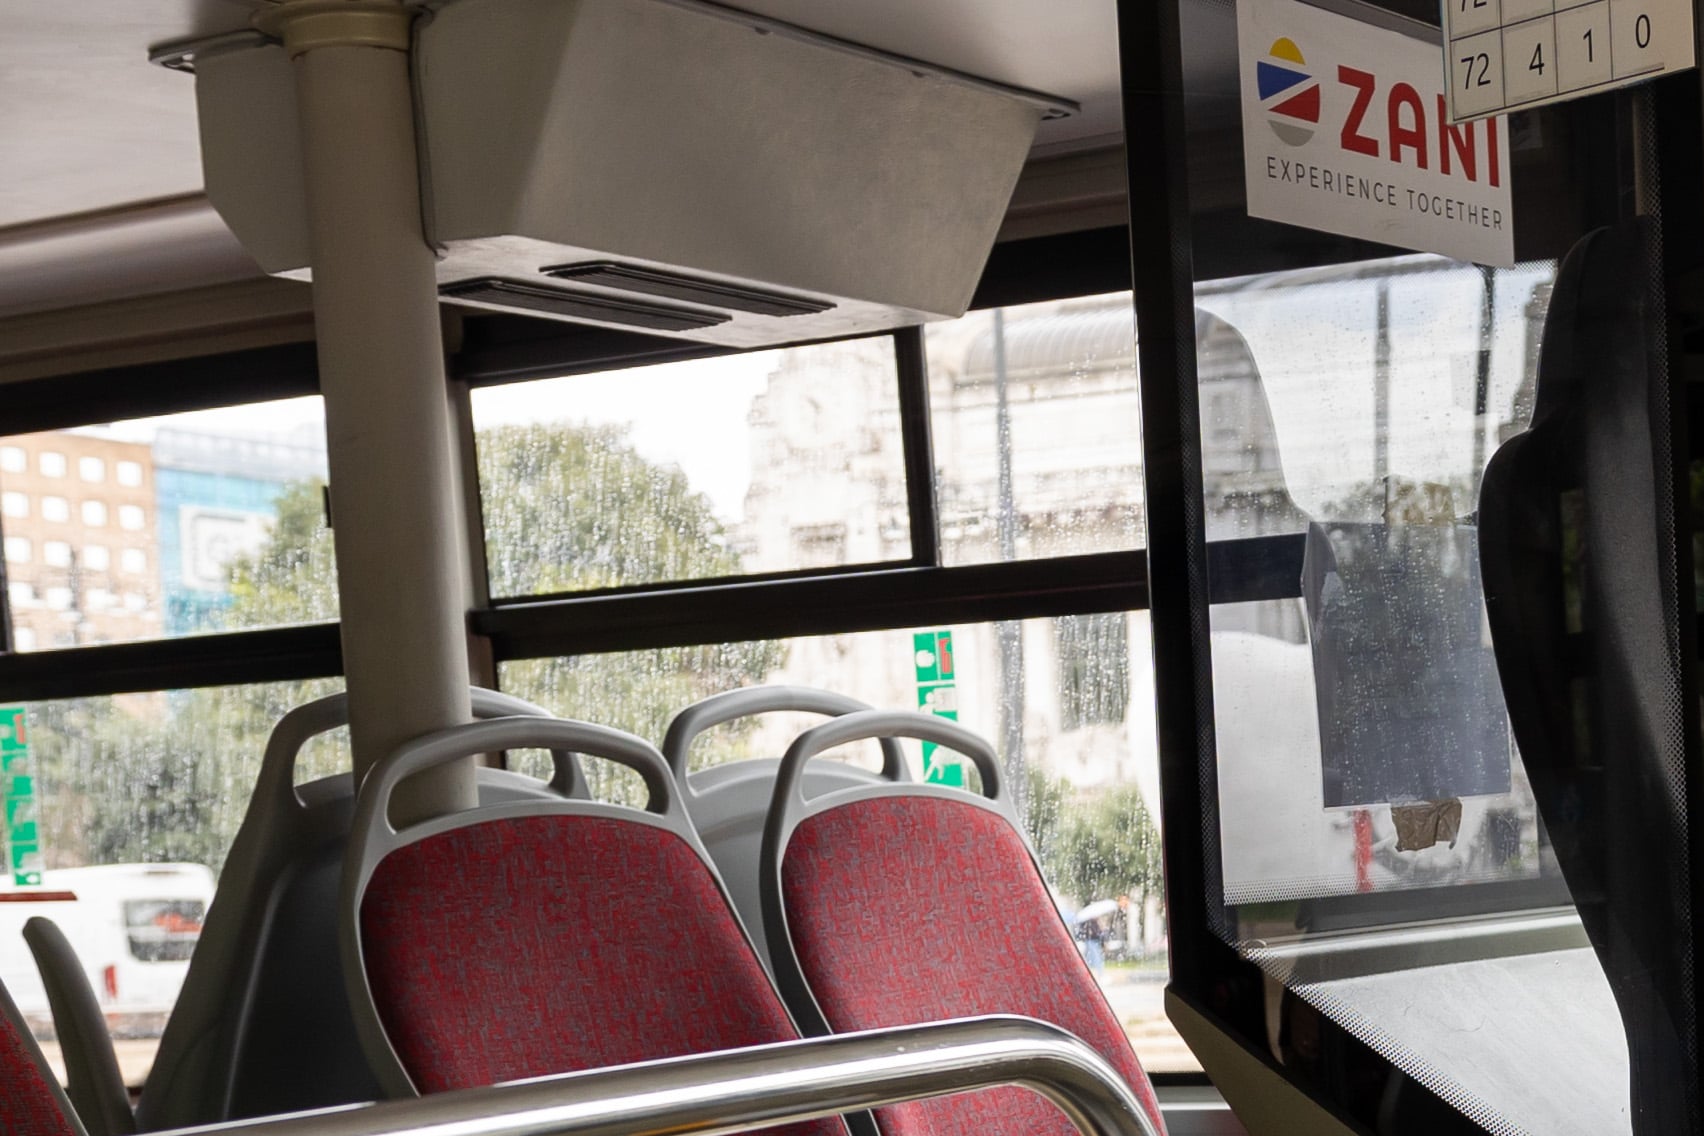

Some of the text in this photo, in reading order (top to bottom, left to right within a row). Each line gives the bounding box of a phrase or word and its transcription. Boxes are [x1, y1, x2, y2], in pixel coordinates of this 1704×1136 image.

[1461, 14, 1651, 90] 72 4 1 0
[1337, 64, 1500, 188] ZANI
[1266, 156, 1502, 231] EXPERIENCE TOGETHER
